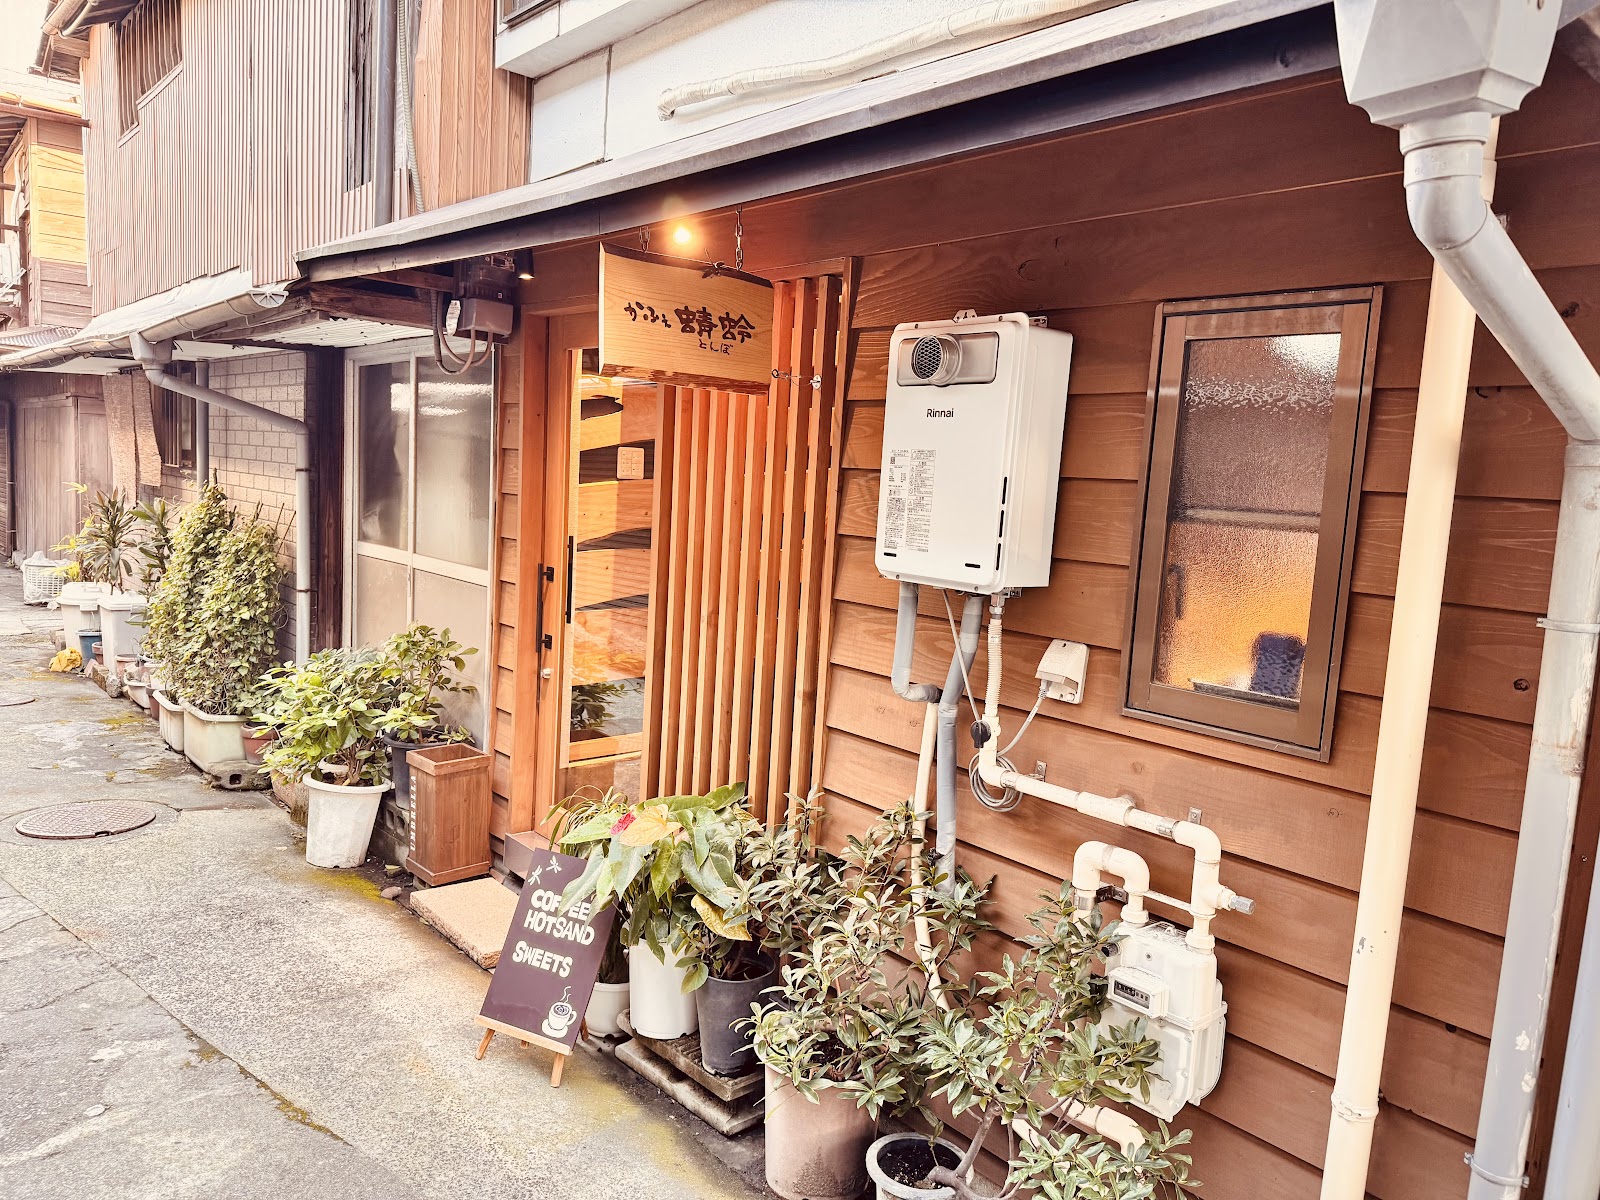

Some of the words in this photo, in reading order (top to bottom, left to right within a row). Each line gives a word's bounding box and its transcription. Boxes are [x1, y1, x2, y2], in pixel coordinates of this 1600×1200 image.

[699, 339, 733, 355] とんぼ
[926, 408, 954, 418] Rinnai
[531, 888, 592, 921] COFEE
[512, 940, 573, 978] SWEETS
